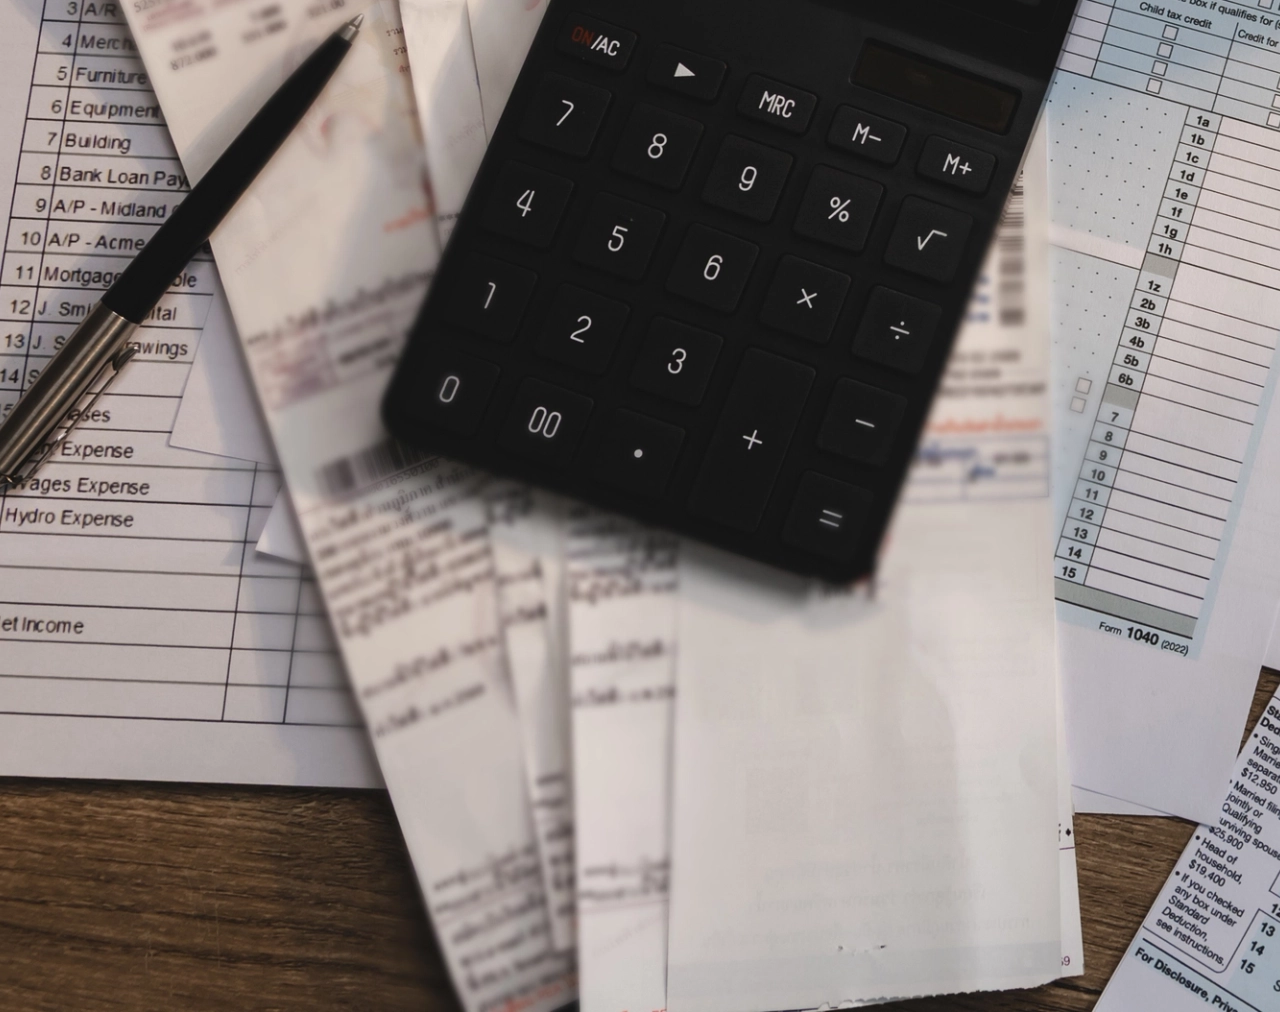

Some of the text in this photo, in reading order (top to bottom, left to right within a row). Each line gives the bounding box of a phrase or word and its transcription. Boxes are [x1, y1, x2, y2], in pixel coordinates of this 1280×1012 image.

[569, 24, 622, 59] ON/AC
[74, 67, 148, 85] Furniture
[555, 99, 574, 126] 7
[757, 90, 796, 118] MRC
[64, 132, 133, 155] Building
[646, 132, 668, 159] 8
[58, 165, 149, 185] Bank Loan
[941, 152, 972, 175] M+
[738, 165, 758, 192] 9
[515, 189, 535, 217] 4
[21, 230, 42, 246] 10
[47, 232, 81, 248] A/P
[95, 233, 146, 253] Acme
[607, 224, 628, 252] 5
[703, 254, 724, 281] 6
[483, 281, 497, 309] 1
[569, 314, 592, 344] 2
[667, 347, 687, 374] 3
[438, 374, 460, 403] 0
[527, 405, 562, 439] 00
[4, 506, 134, 529] Hydro Expense
[21, 616, 85, 635] Income
[1097, 620, 1189, 657] Form 1040 (2022)
